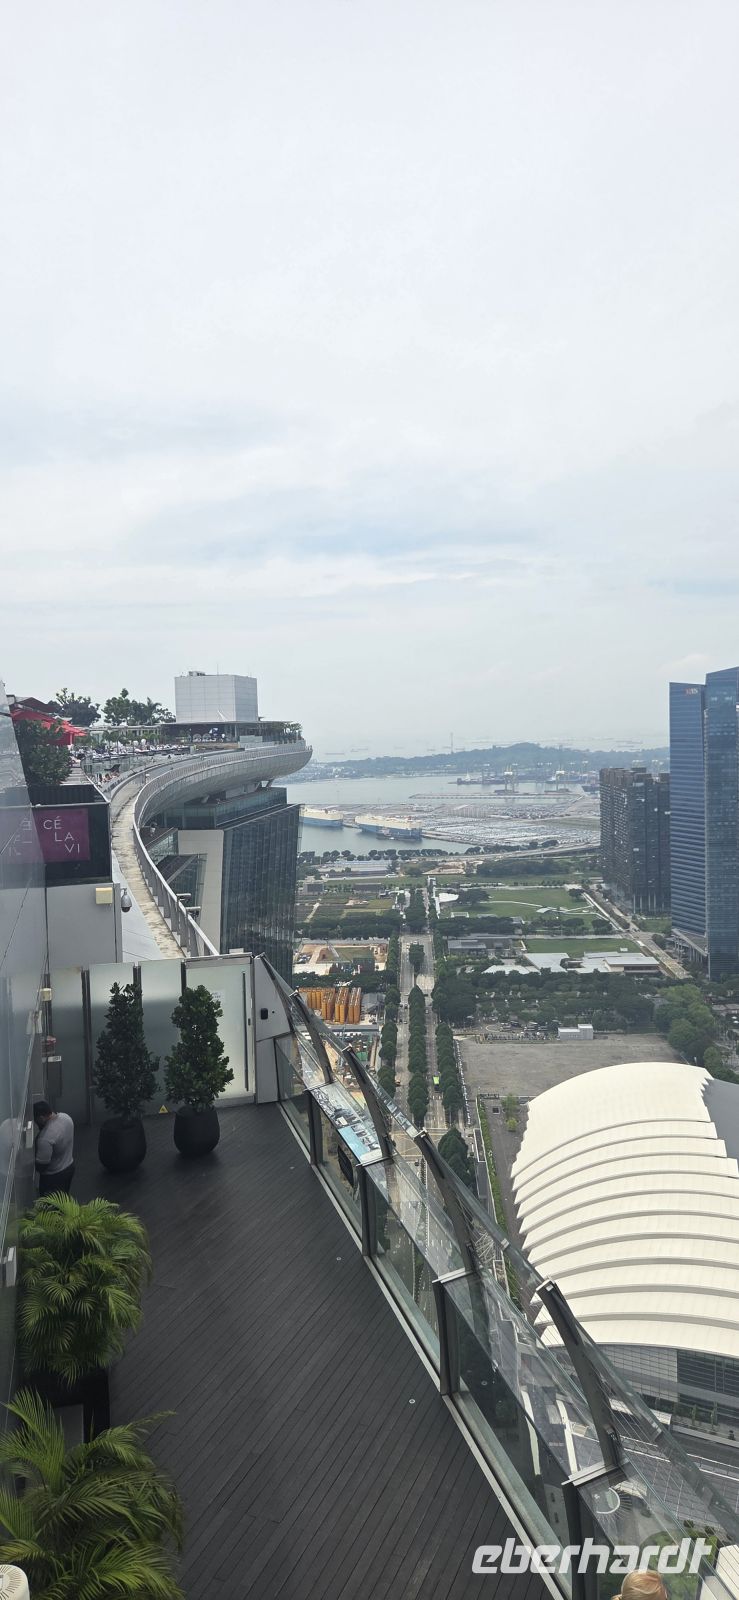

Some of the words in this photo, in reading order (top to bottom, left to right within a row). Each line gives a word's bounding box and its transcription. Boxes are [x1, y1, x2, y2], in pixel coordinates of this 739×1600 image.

[43, 816, 62, 830] CÉ
[54, 832, 74, 842] LA
[65, 843, 80, 854] VI
